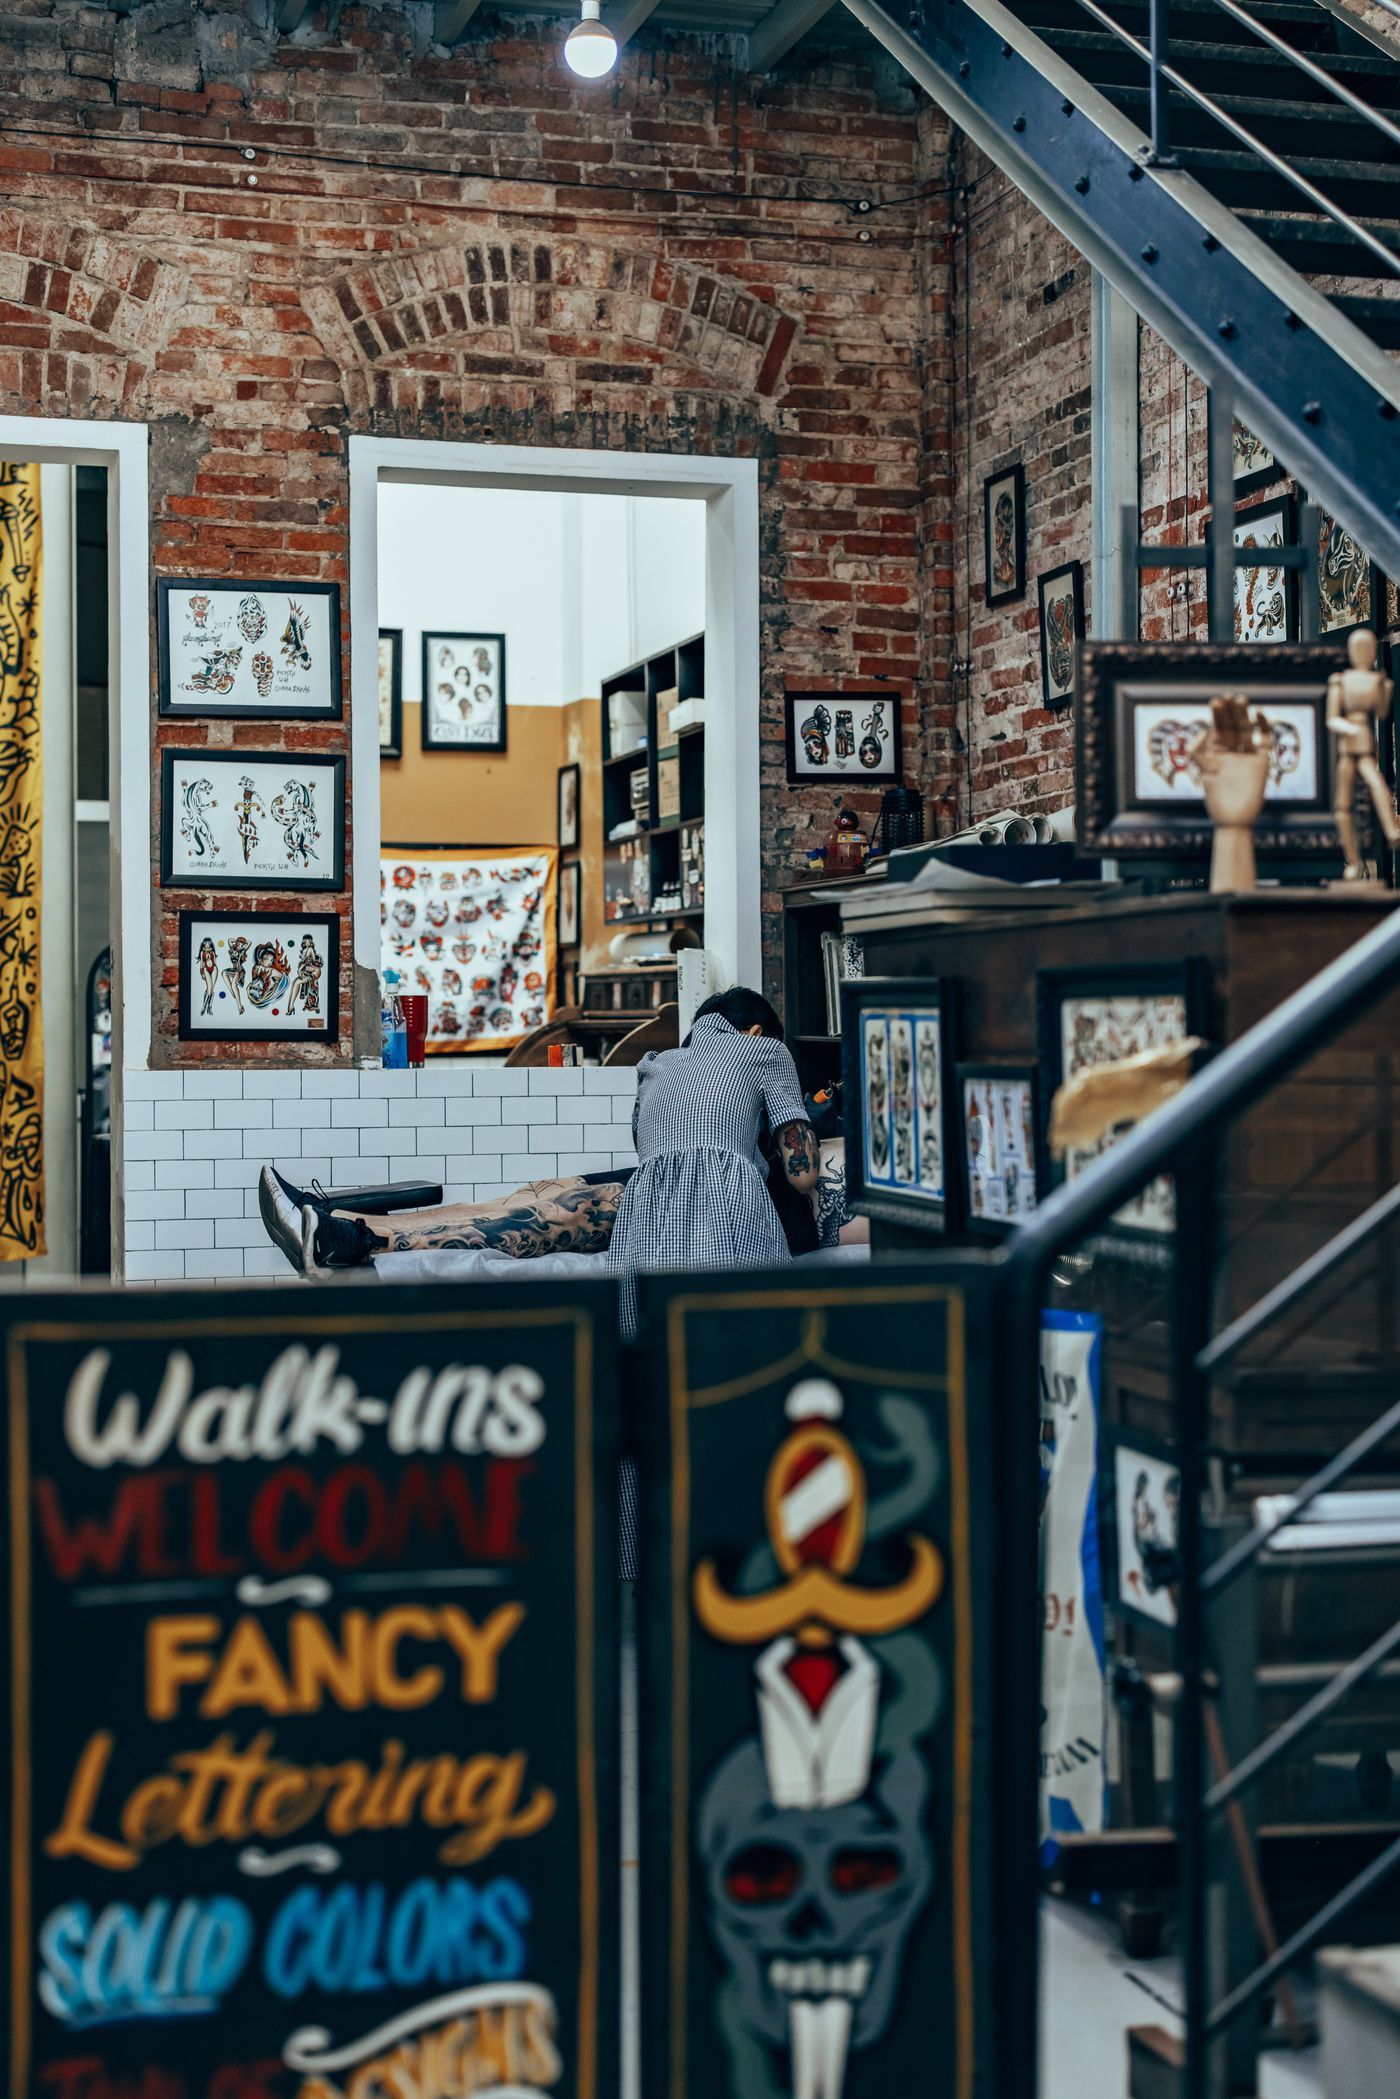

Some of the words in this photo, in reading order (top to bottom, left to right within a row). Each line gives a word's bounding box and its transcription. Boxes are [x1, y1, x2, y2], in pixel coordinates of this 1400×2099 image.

[213, 621, 232, 630] 2017
[64, 1343, 546, 1467] Walk-ins
[37, 1458, 536, 1580] WELCOME
[146, 1603, 525, 1721] FANCY
[46, 1731, 556, 1870] Lettering
[38, 1894, 253, 2025] SOLID
[264, 1876, 532, 1995] COLORS
